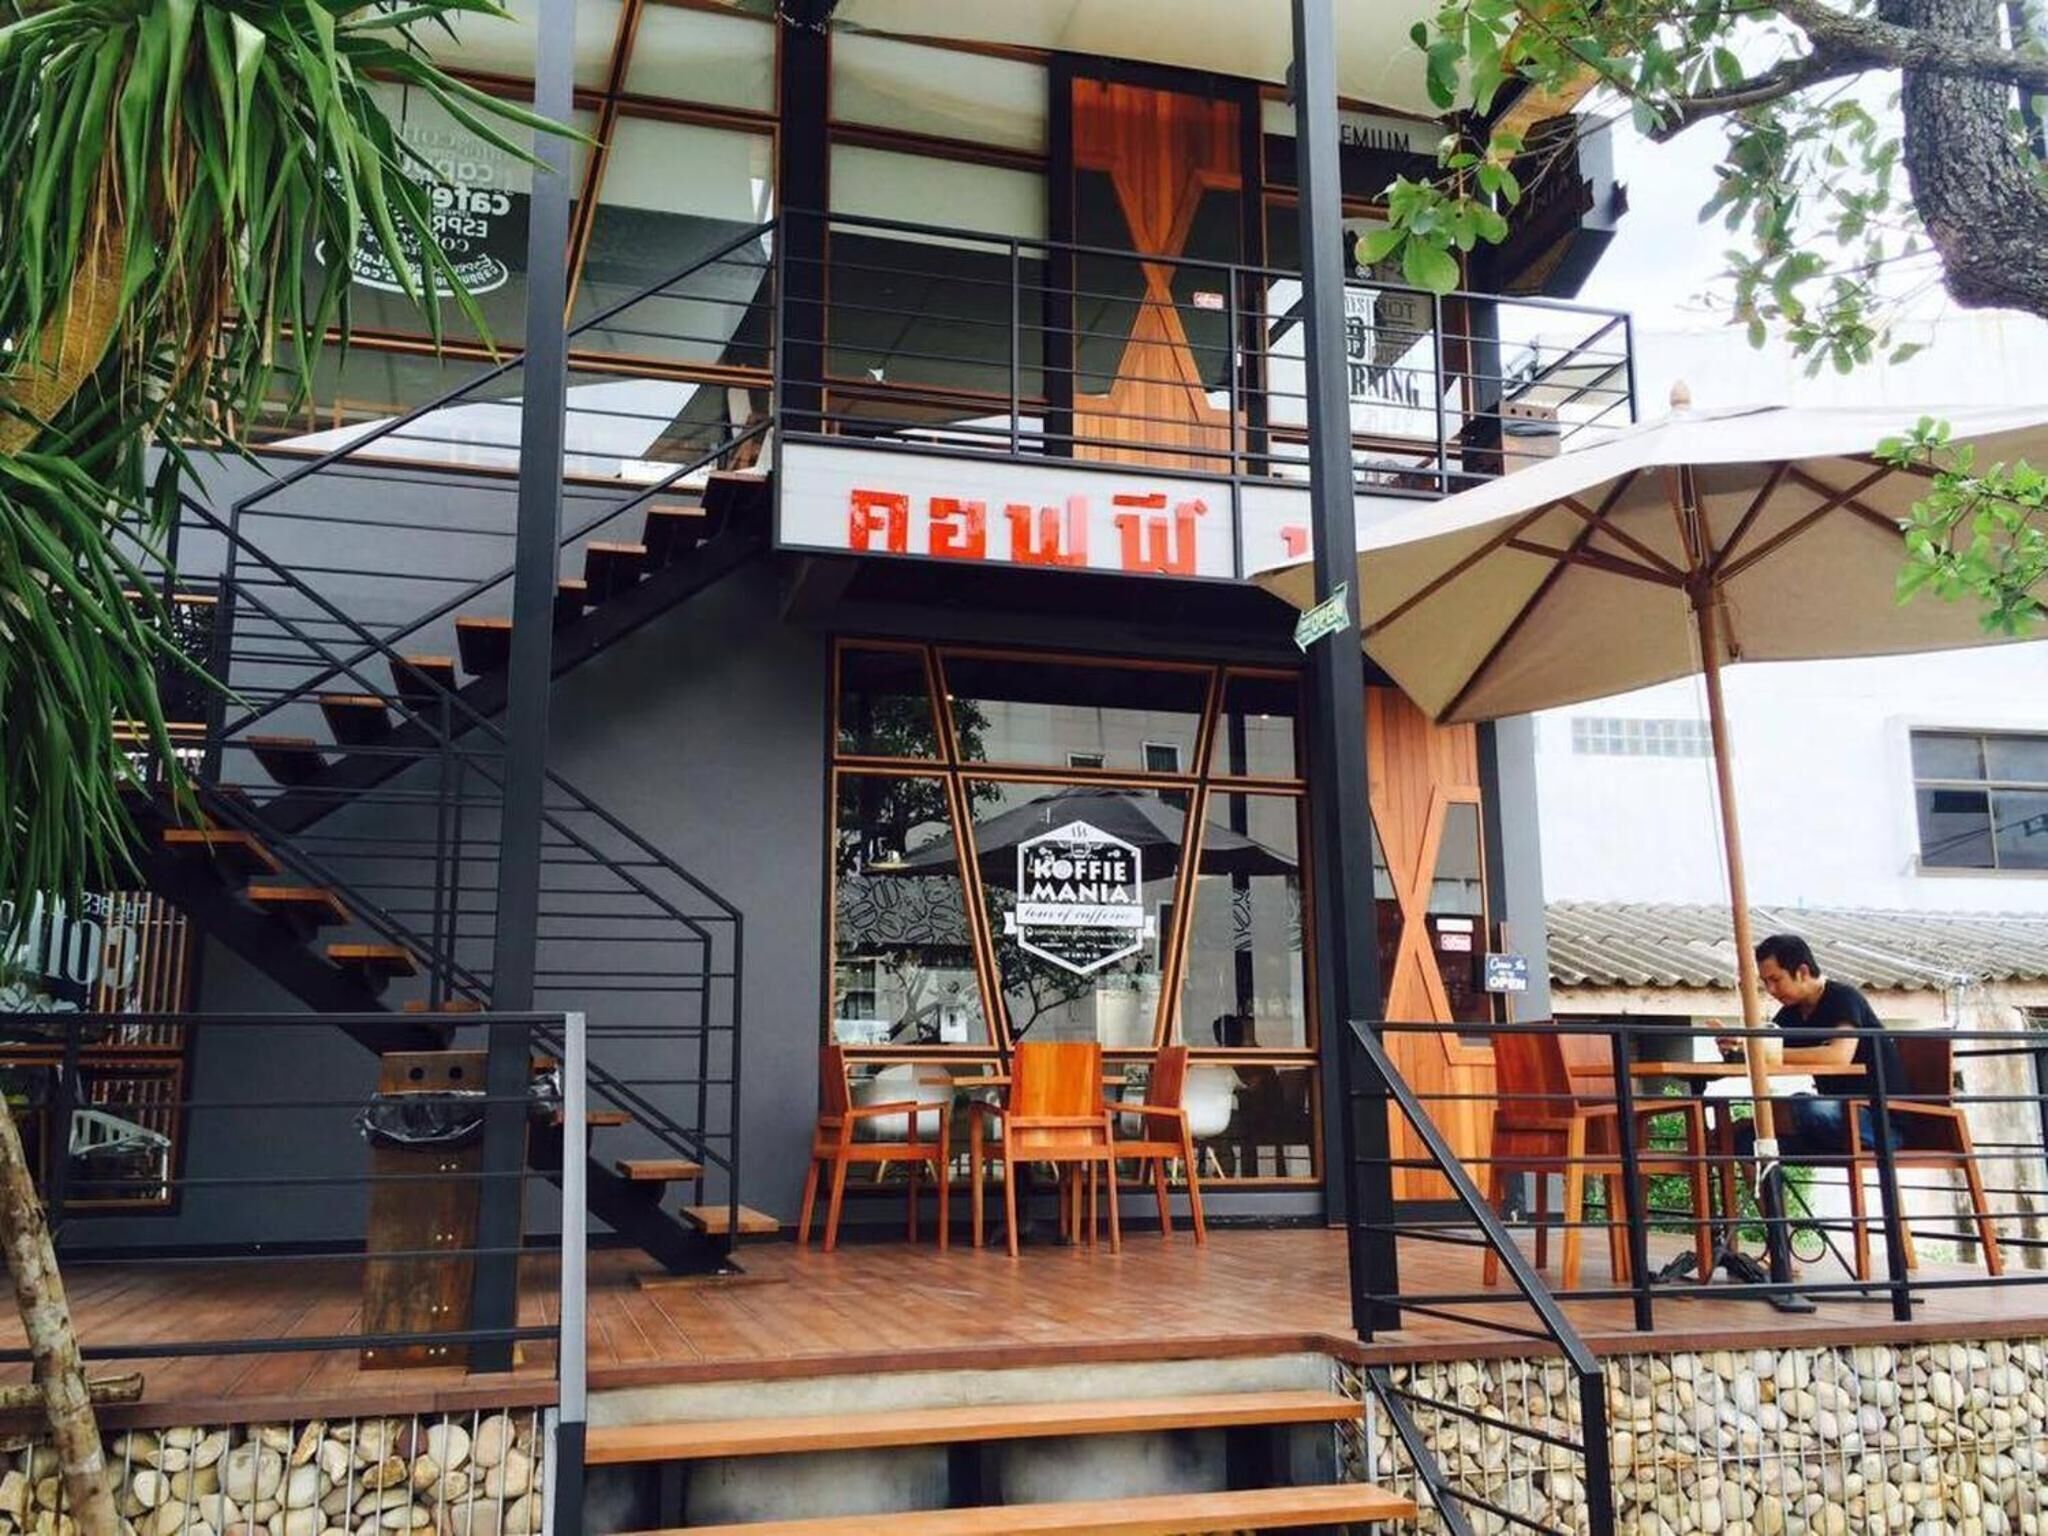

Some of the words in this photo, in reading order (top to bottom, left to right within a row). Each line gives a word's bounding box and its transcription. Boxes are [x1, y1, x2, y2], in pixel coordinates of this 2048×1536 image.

[1341, 123, 1411, 153] EMIUM
[1350, 364, 1420, 408] RNING
[1033, 858, 1127, 882] KOFFIE
[1030, 881, 1131, 903] MANIA
[1489, 976, 1527, 991] OPEN
